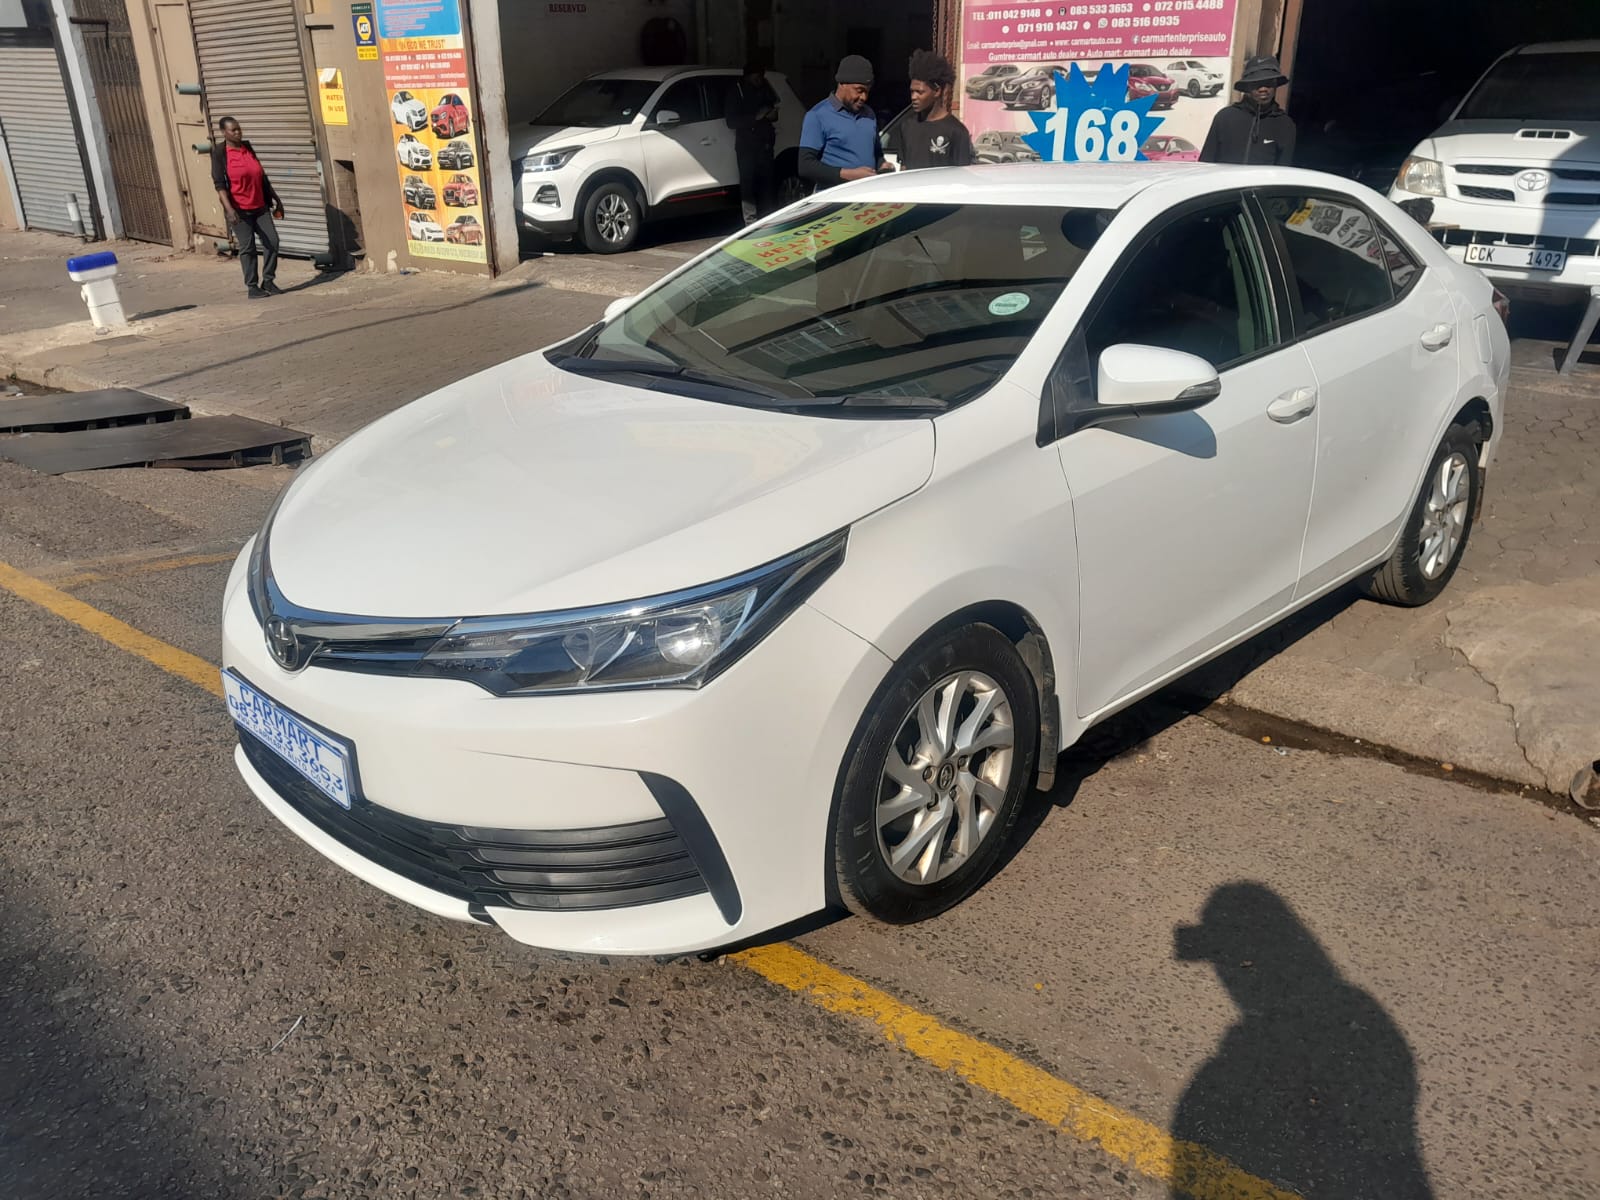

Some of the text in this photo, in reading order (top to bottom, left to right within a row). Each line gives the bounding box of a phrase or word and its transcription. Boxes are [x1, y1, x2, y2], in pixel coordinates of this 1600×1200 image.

[549, 3, 587, 13] RESERVED
[1003, 10, 1019, 19] 042
[1021, 9, 1041, 18] 9148
[1070, 6, 1088, 15] 083
[1089, 4, 1107, 14] 533
[1109, 3, 1133, 13] 3653
[1154, 1, 1172, 11] 072
[1175, 0, 1194, 10] 015
[1196, 0, 1224, 9] 4488
[1017, 23, 1034, 33] 071
[1036, 22, 1054, 32] 910
[1056, 21, 1078, 31] 1437
[1112, 18, 1130, 28] 083
[1153, 16, 1180, 26] 0935
[1141, 32, 1227, 44] carmartenterpriseauto
[1043, 51, 1057, 60] auto
[1058, 50, 1078, 59] dealer
[1086, 49, 1104, 58] Auto
[1123, 48, 1151, 57] carmart
[1152, 48, 1168, 56] auto
[1169, 47, 1192, 56] dealer
[1045, 107, 1140, 161] 168
[1470, 246, 1562, 268] CCK 1492
[239, 685, 322, 761] CARMART
[263, 719, 294, 752] 533
[300, 748, 344, 792] 3653
